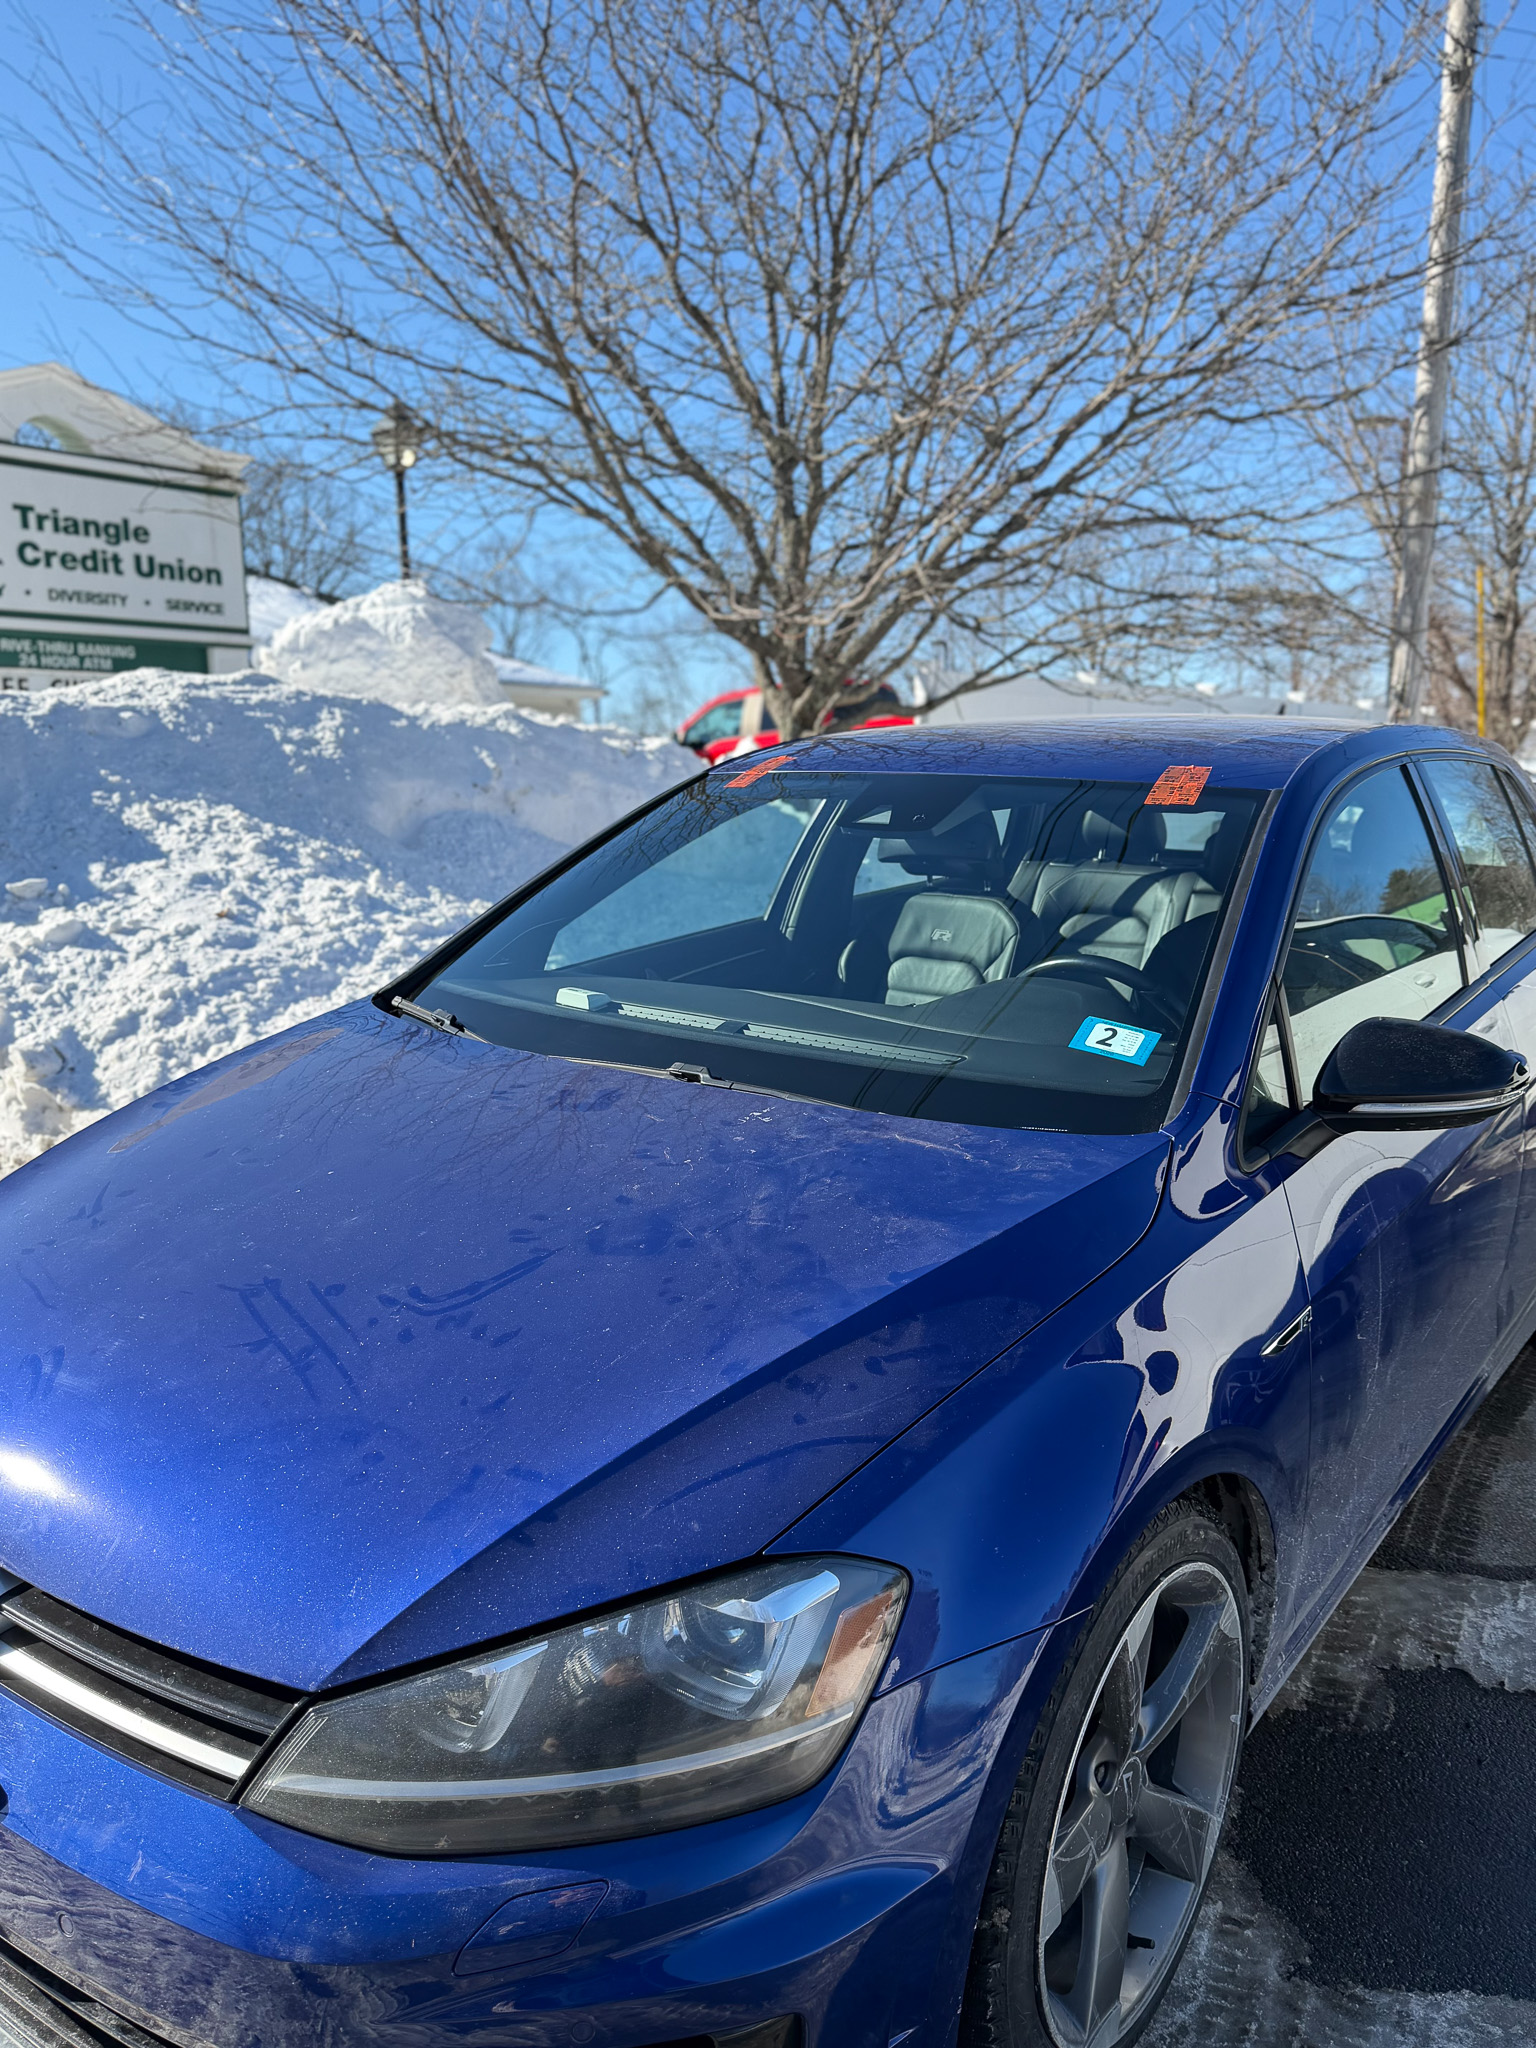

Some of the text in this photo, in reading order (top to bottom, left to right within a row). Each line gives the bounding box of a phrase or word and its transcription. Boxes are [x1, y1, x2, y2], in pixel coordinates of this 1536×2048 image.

[12, 503, 150, 546] Triangle
[17, 541, 223, 586] Credit Union
[47, 587, 225, 616] DIVERSITY SERVICE
[40, 655, 81, 669] HOUR
[82, 656, 114, 671] ATM
[1095, 1027, 1118, 1048] 2
